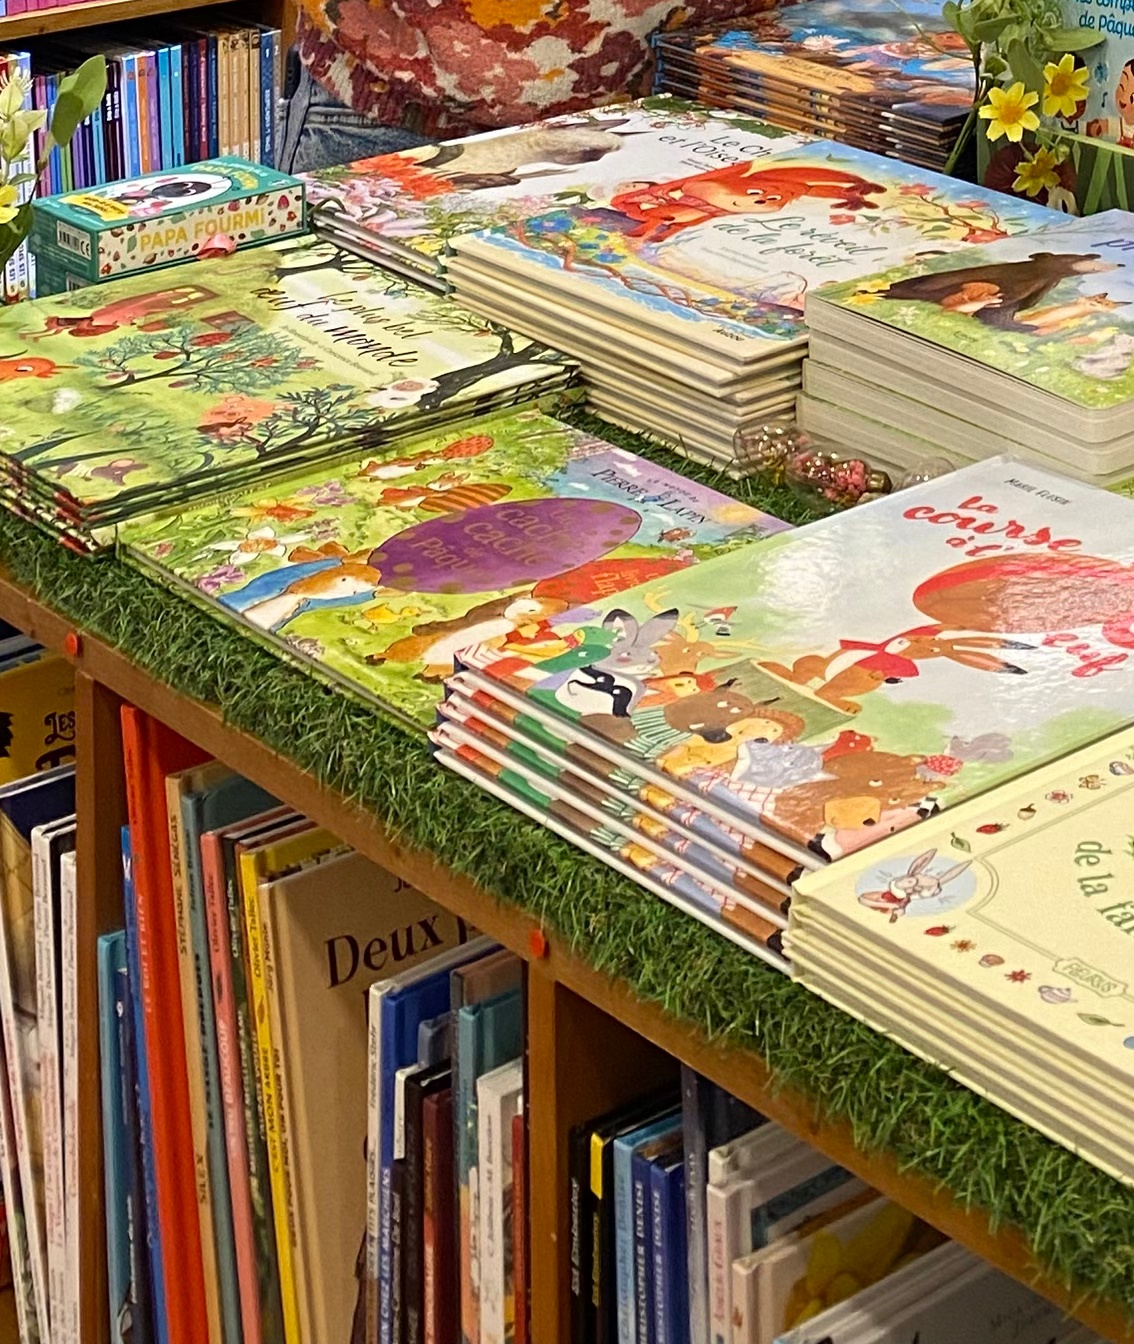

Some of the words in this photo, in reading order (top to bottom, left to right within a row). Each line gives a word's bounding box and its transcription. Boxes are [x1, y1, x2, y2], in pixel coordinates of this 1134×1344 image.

[1078, 13, 1095, 29] de
[140, 226, 188, 253] PAPA
[801, 227, 889, 256] réveil
[759, 242, 857, 268] forêt
[383, 321, 433, 339] bel
[903, 504, 1082, 552] course
[1075, 840, 1113, 872] de
[1078, 875, 1110, 899] la
[323, 915, 444, 989] Deux
